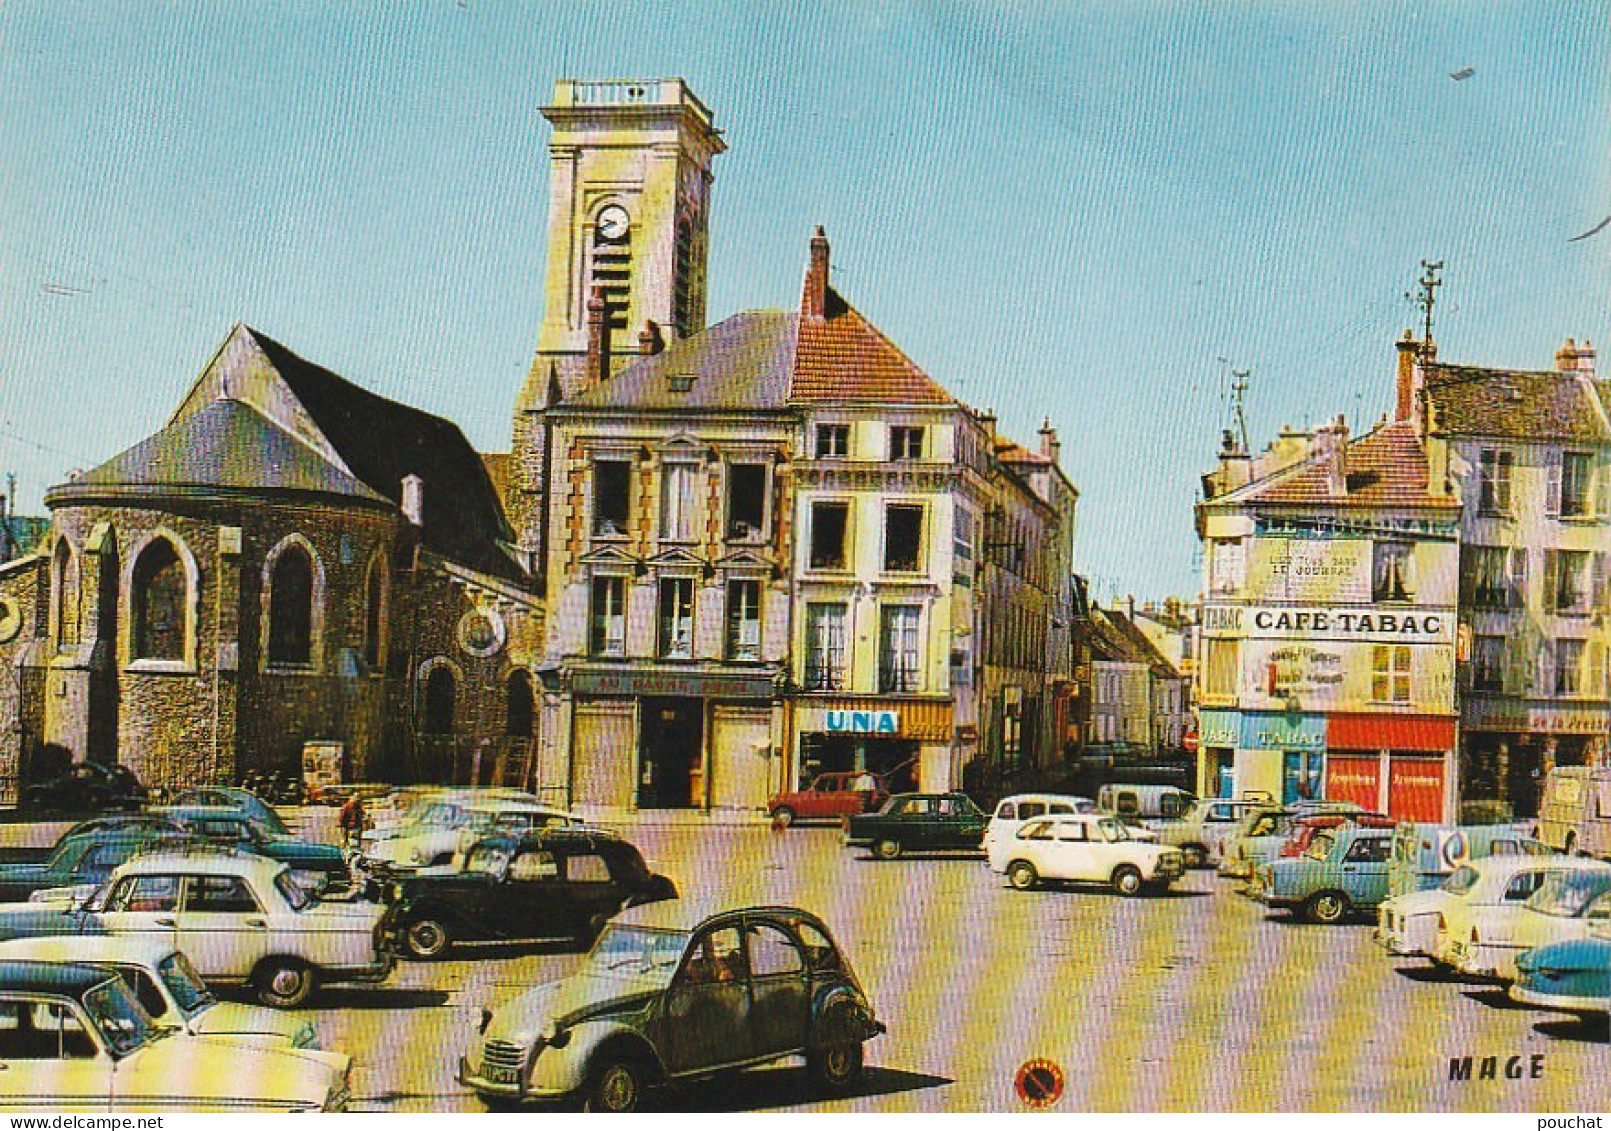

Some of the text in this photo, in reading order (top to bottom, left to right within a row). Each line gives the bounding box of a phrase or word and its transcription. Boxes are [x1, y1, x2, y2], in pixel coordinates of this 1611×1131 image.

[1205, 607, 1243, 630] TABAC
[826, 711, 895, 733] UNA
[1258, 732, 1324, 746] TABAC
